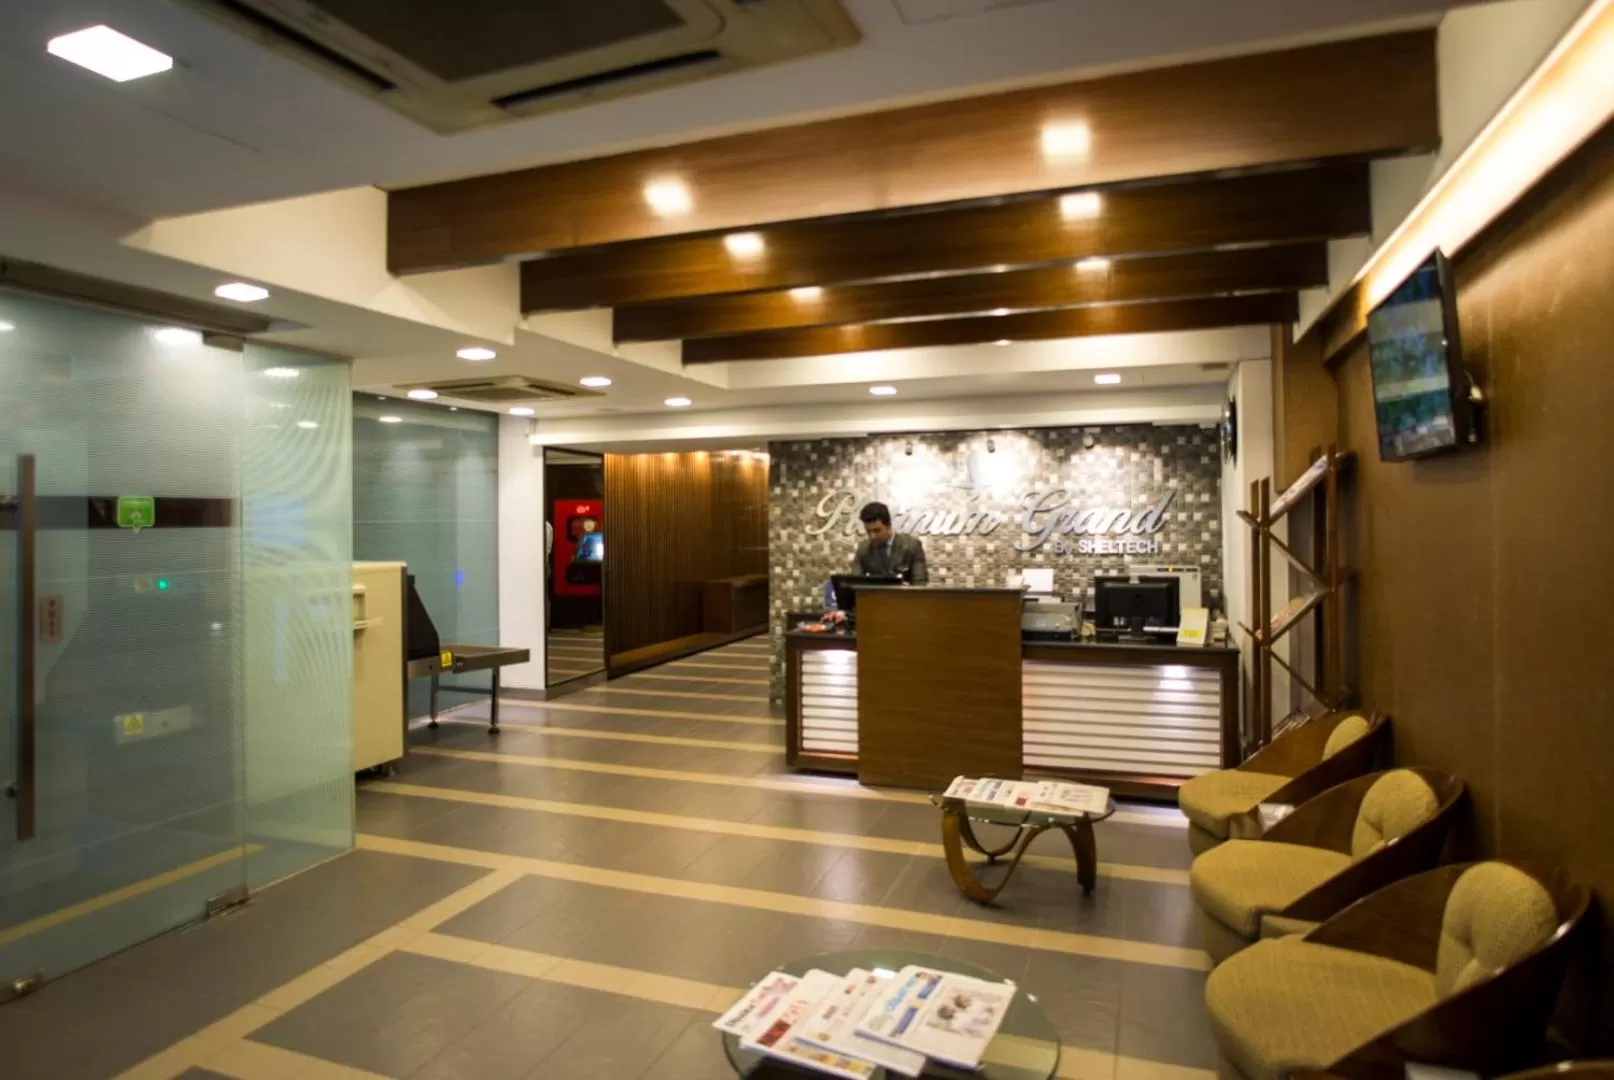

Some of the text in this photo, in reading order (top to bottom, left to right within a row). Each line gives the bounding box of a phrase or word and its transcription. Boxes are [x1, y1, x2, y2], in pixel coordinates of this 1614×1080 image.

[805, 488, 1177, 552] Plinum Grand
[1078, 539, 1158, 554] SHELTECH
